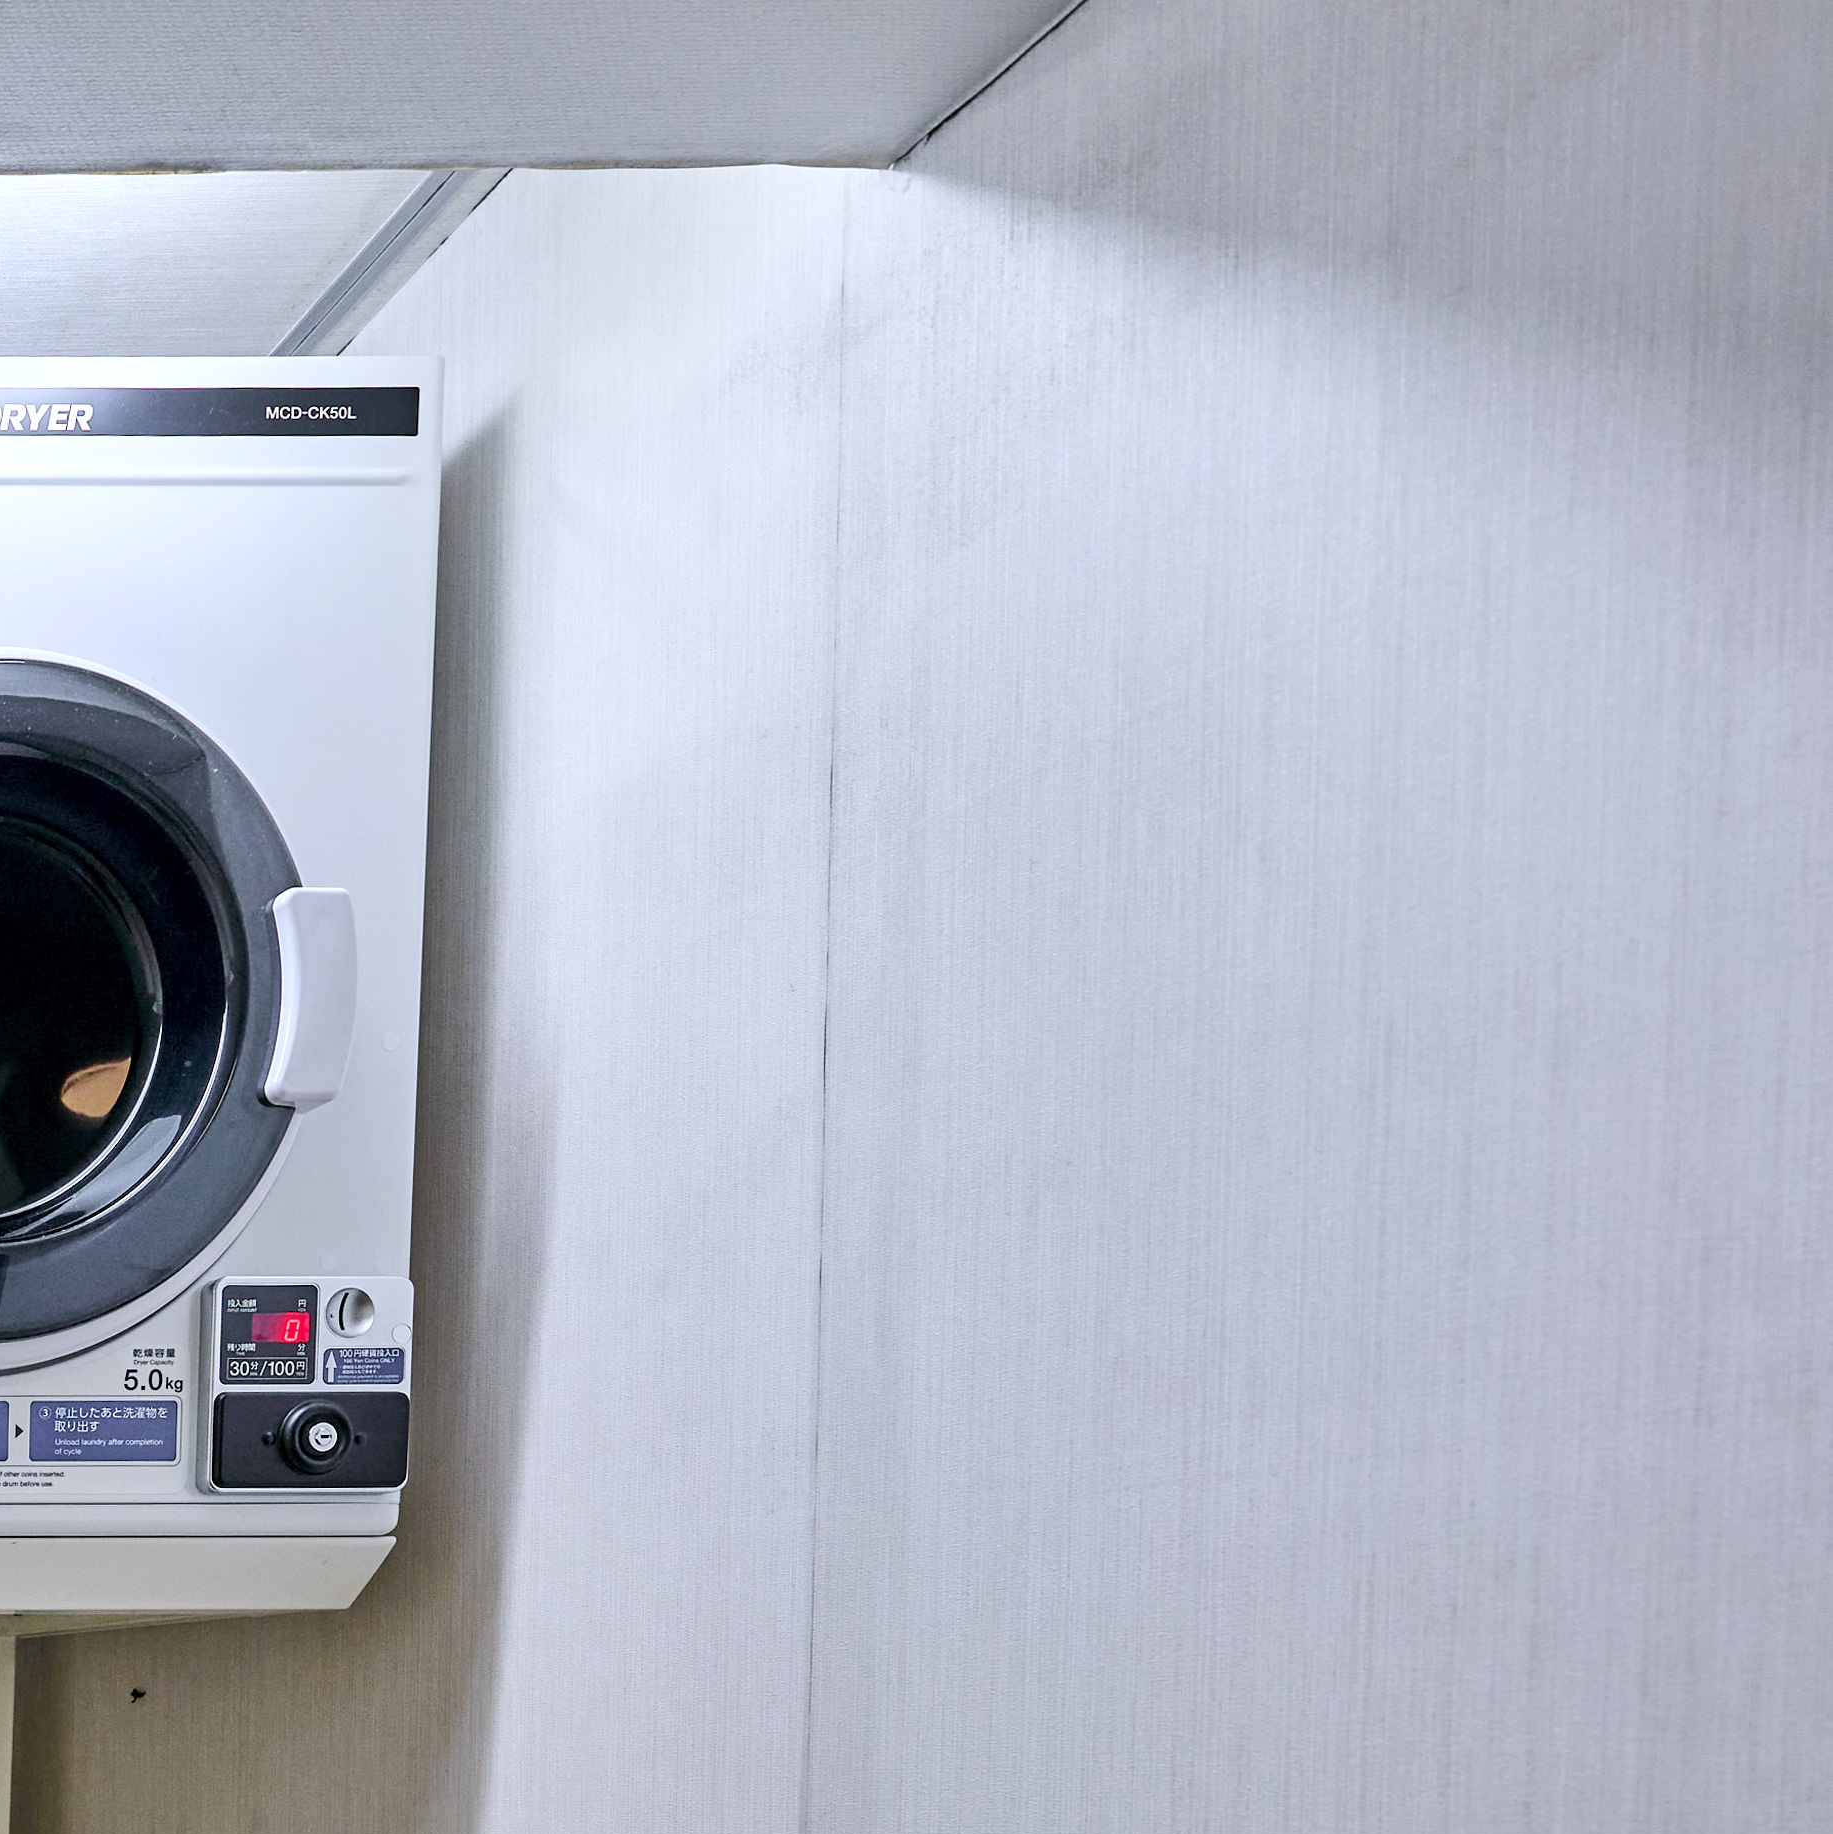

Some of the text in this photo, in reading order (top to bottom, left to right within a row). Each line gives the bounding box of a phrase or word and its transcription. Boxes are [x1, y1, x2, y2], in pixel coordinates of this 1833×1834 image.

[265, 406, 357, 420] MCD-CK50L
[228, 1299, 306, 1307] 投入金額 円
[284, 1320, 300, 1341] 0
[227, 1343, 255, 1352] 残り時間
[133, 1349, 175, 1358] 乾燥容量
[124, 1369, 183, 1392] 5.0 kg
[55, 1407, 167, 1419] 停止したあと洗濯物を
[55, 1421, 99, 1432] 取り出す
[82, 1439, 107, 1447] laundry
[126, 1439, 163, 1447] completion
